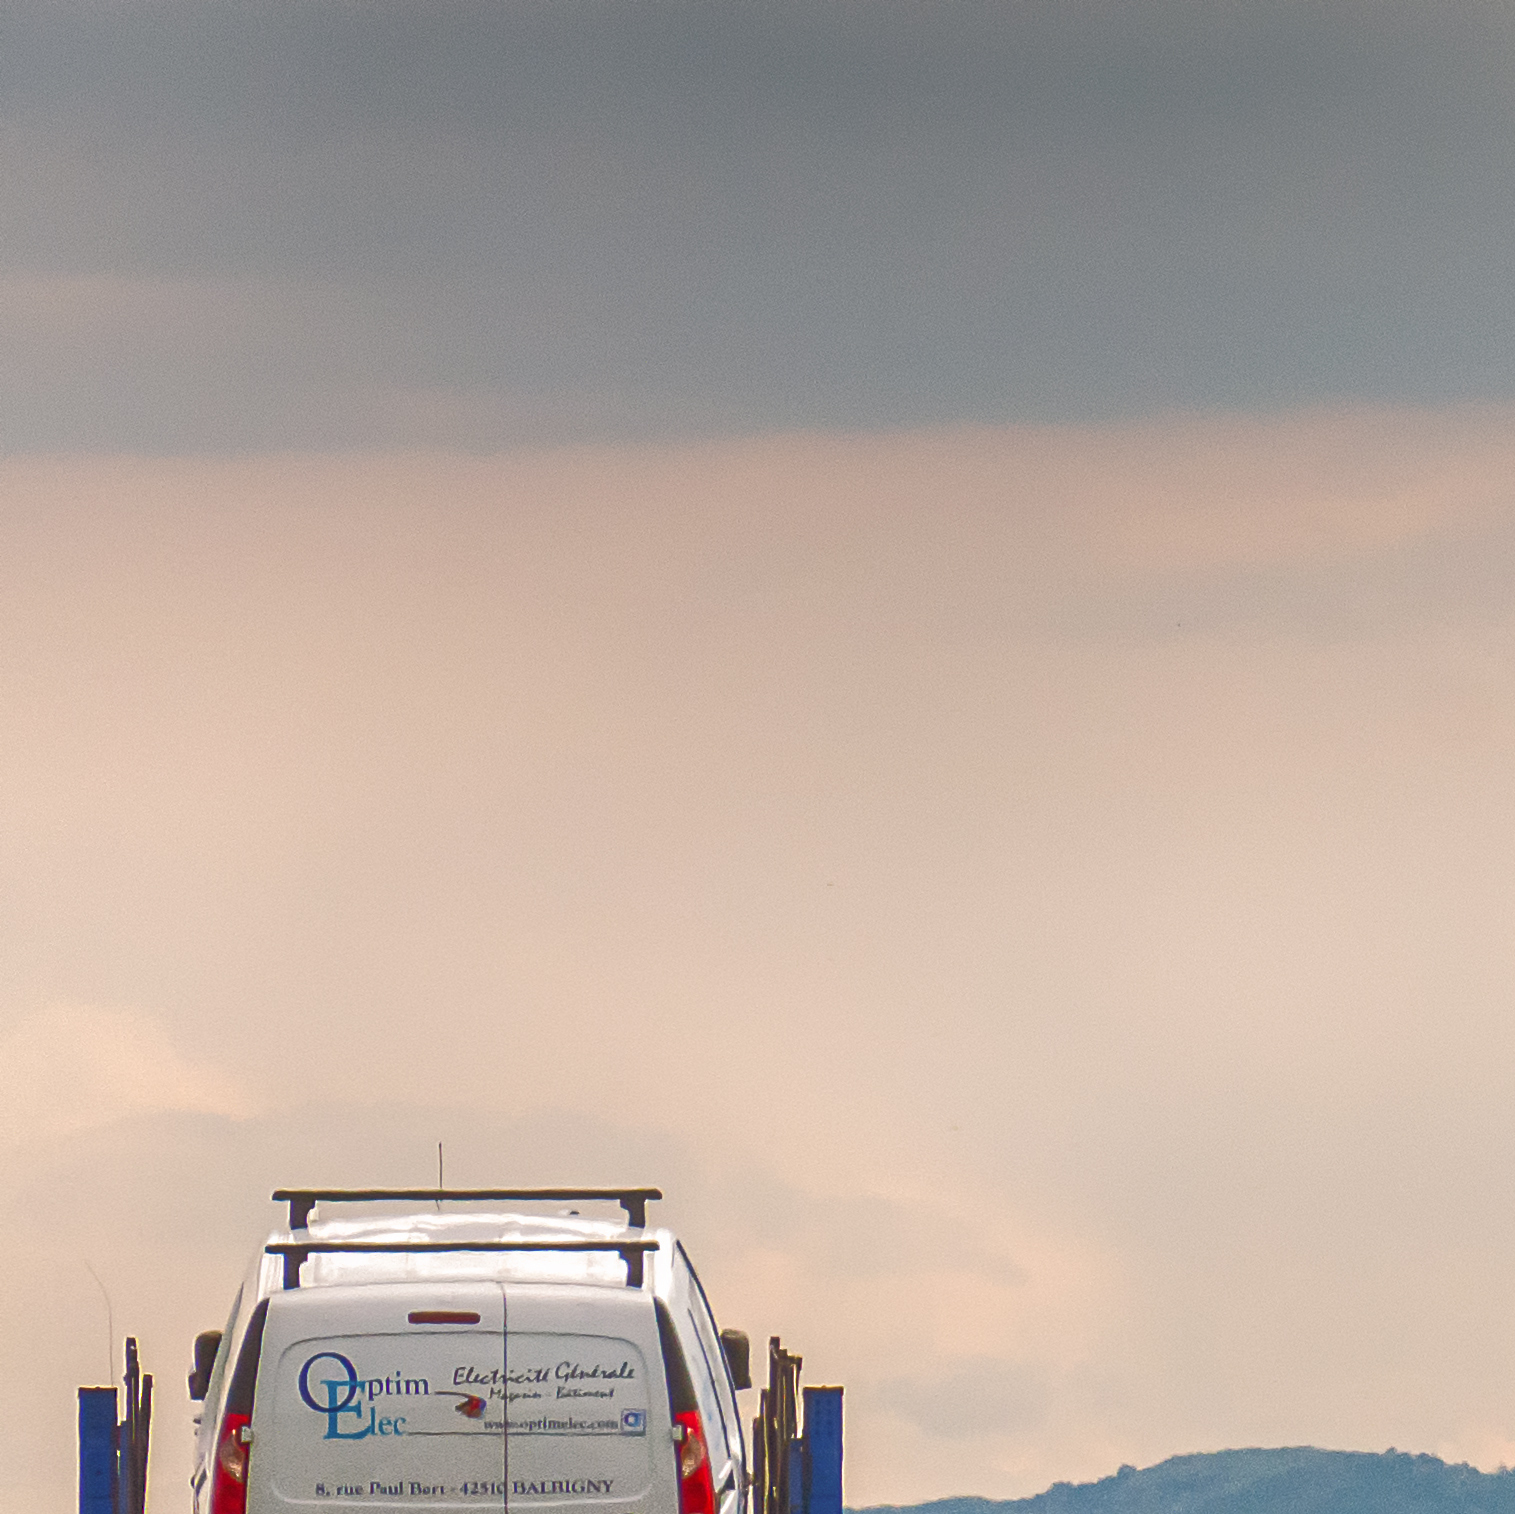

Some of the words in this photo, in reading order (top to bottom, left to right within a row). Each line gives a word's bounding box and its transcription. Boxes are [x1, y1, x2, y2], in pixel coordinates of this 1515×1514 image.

[299, 1352, 430, 1413] Optim
[320, 1379, 407, 1440] Elec
[336, 1484, 363, 1496] rue
[369, 1481, 404, 1496] Paul
[512, 1479, 614, 1495] BALBIGNY
